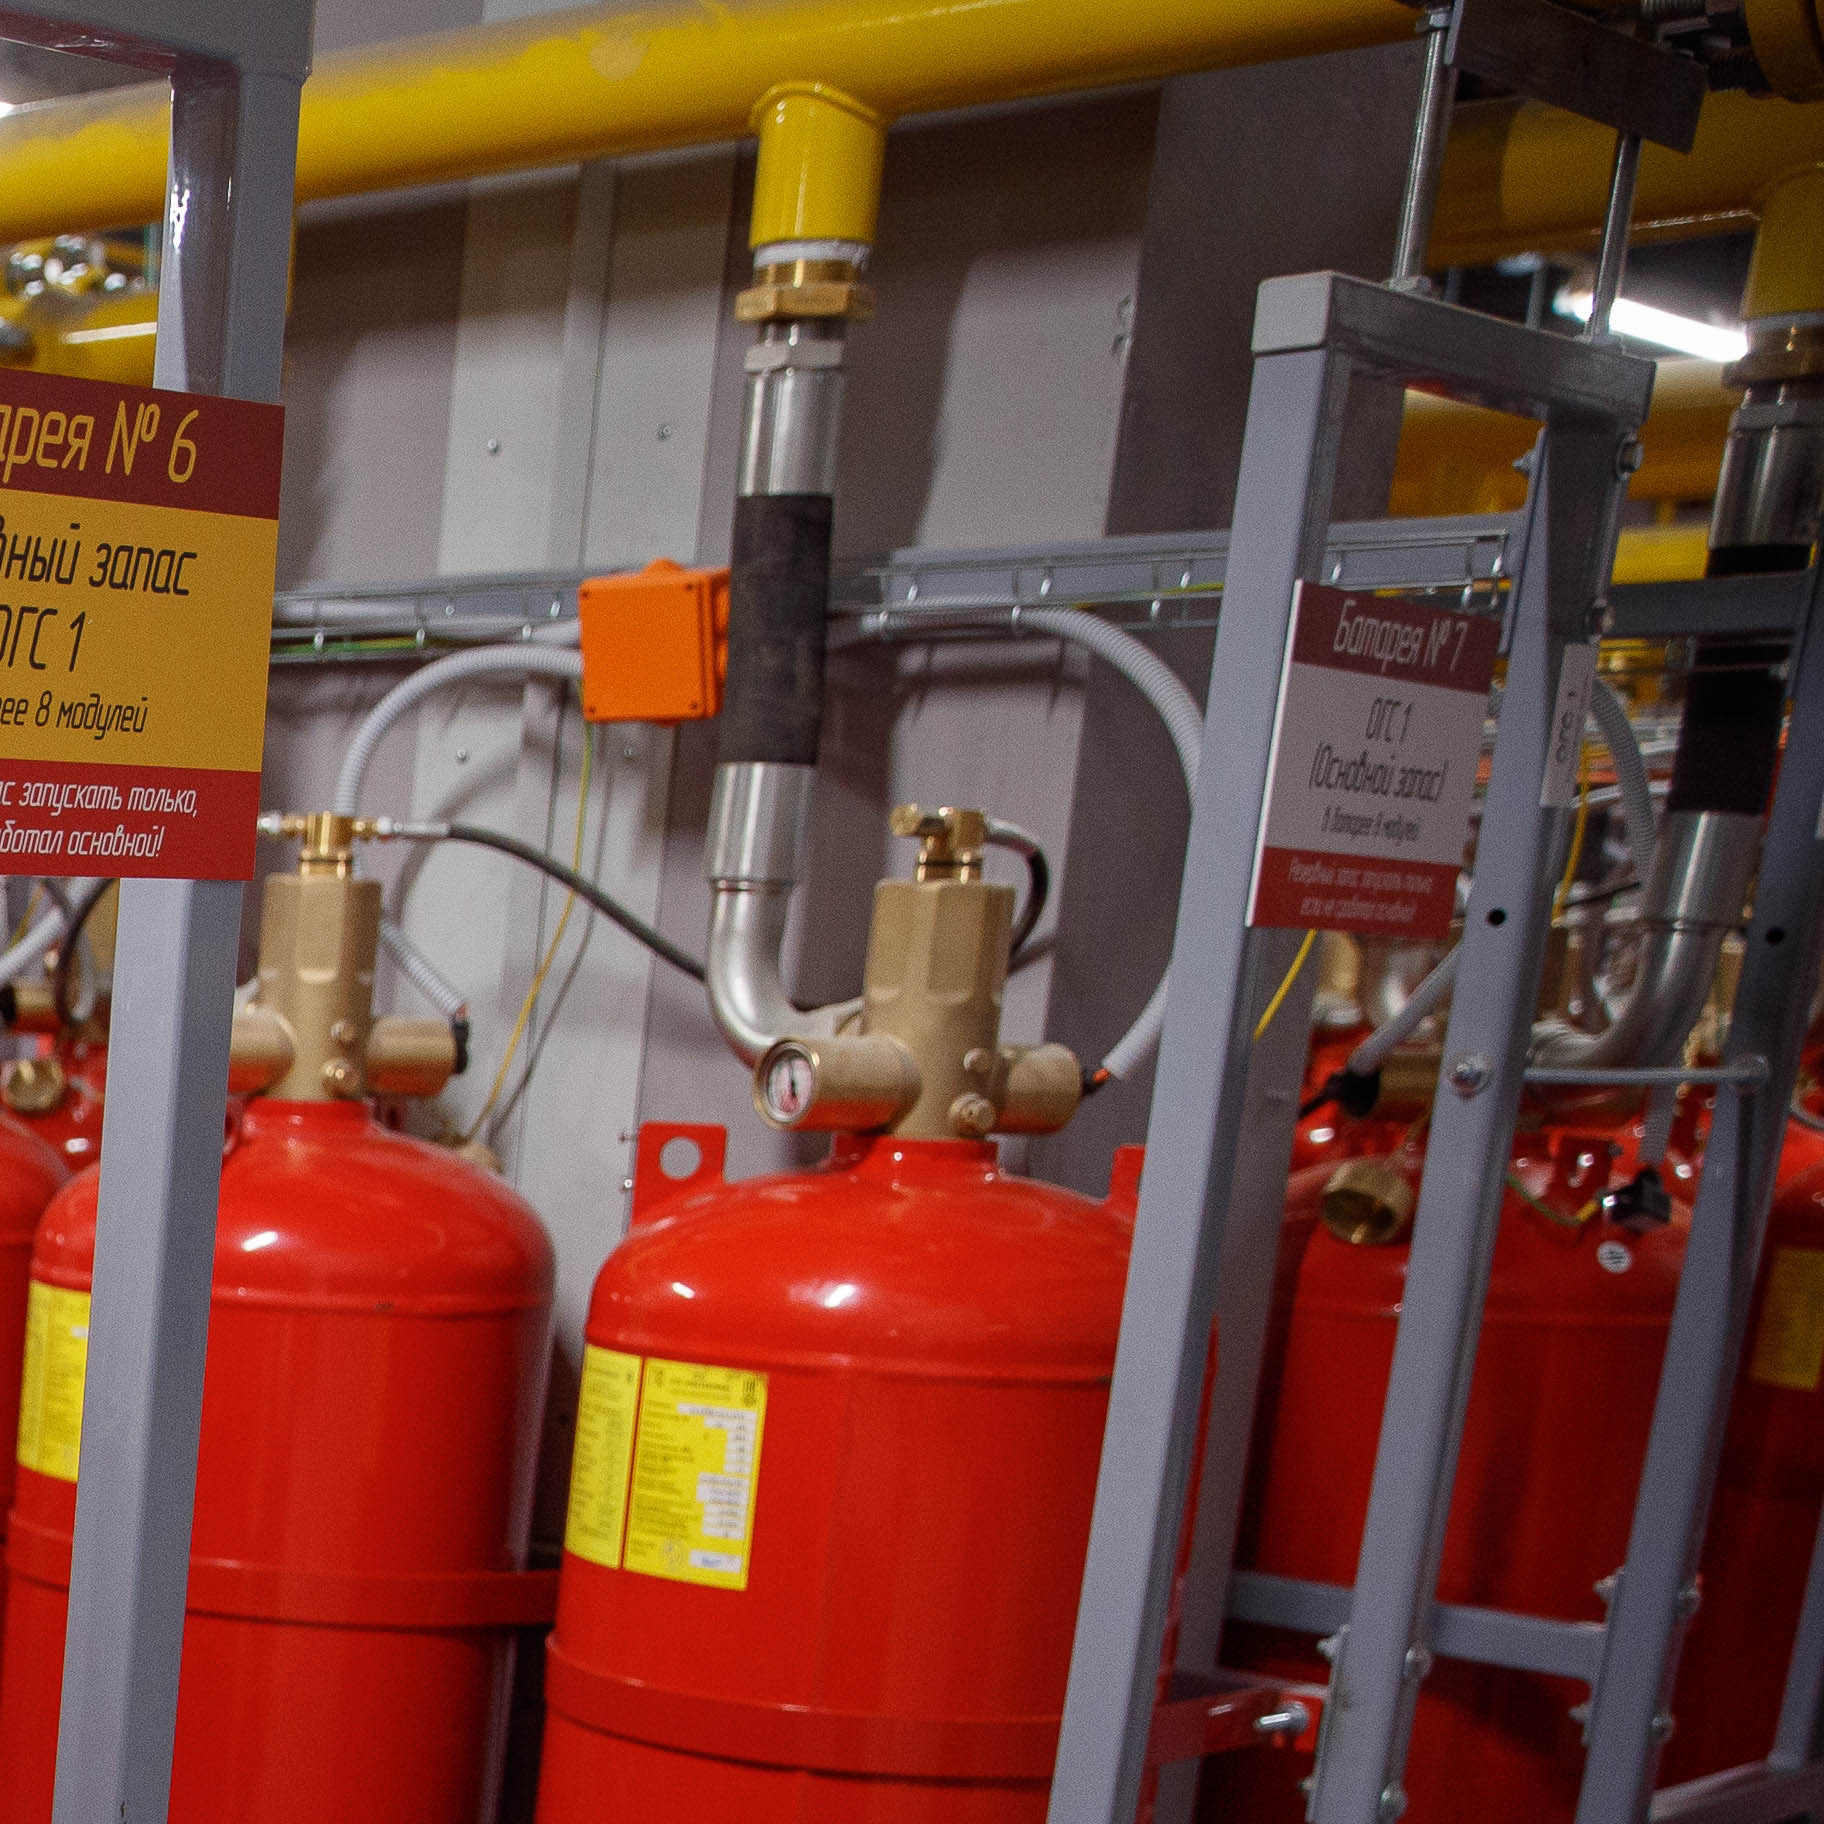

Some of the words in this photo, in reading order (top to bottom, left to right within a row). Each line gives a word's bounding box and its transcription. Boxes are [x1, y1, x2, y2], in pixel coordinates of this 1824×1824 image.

[168, 409, 199, 482] 6
[89, 542, 197, 595] запас
[69, 612, 85, 672] 1
[1333, 600, 1421, 672] Батарея
[1452, 623, 1468, 671] 7
[35, 690, 51, 726] 8
[56, 693, 148, 740] модулей
[1401, 704, 1411, 741] 1
[18, 778, 123, 815] запускать
[127, 786, 197, 818] только,
[66, 825, 165, 858] основной!
